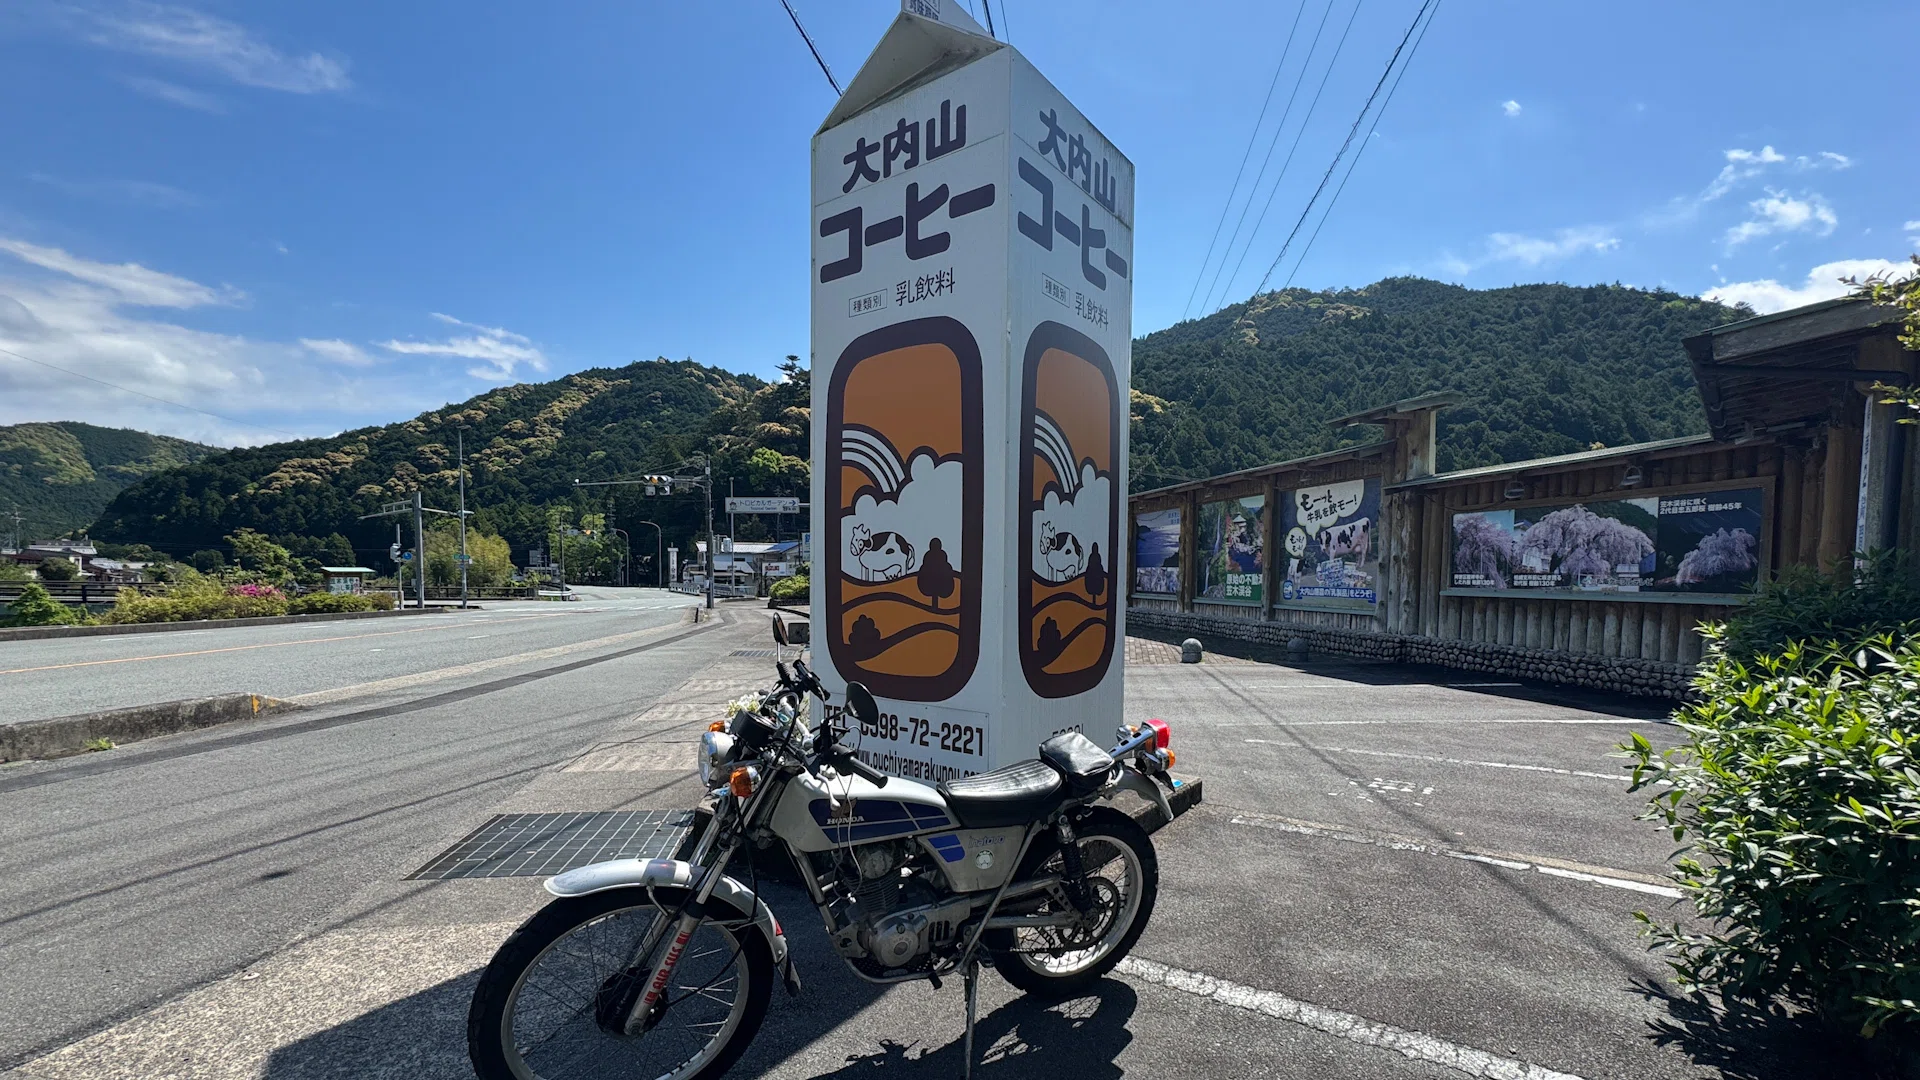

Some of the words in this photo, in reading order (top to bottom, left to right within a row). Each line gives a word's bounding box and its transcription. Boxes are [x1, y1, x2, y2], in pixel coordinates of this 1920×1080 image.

[842, 98, 968, 194] 大内山
[1038, 107, 1116, 213] 大内山
[820, 181, 996, 284] コーヒー
[1017, 156, 1128, 292] コーヒー
[853, 292, 882, 313] 種類別
[895, 266, 956, 307] 乳飲料
[1044, 277, 1068, 304] 種類別
[1074, 290, 1109, 331] 乳飲料
[1300, 489, 1333, 511] モーっと
[1307, 494, 1358, 523] 牛乳を飲モー!
[826, 815, 865, 825] HONDA
